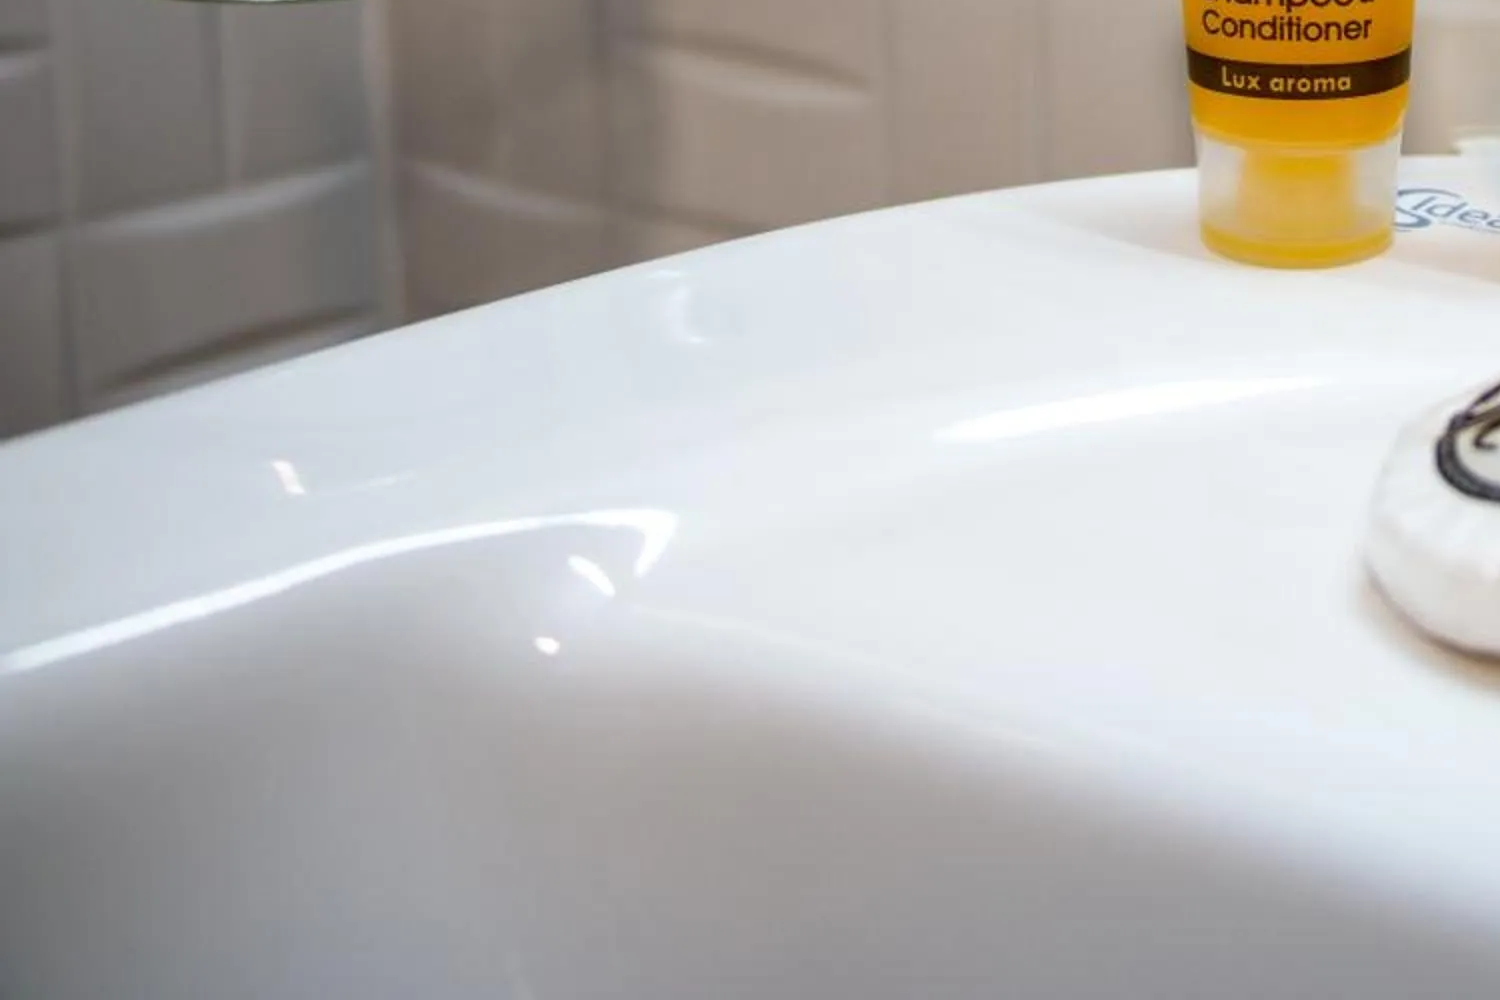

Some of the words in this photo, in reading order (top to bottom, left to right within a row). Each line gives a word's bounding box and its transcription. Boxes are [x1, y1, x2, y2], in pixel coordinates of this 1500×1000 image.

[1202, 10, 1373, 42] Conditioner
[1221, 65, 1262, 91] Lux
[1269, 73, 1352, 93] aroma
